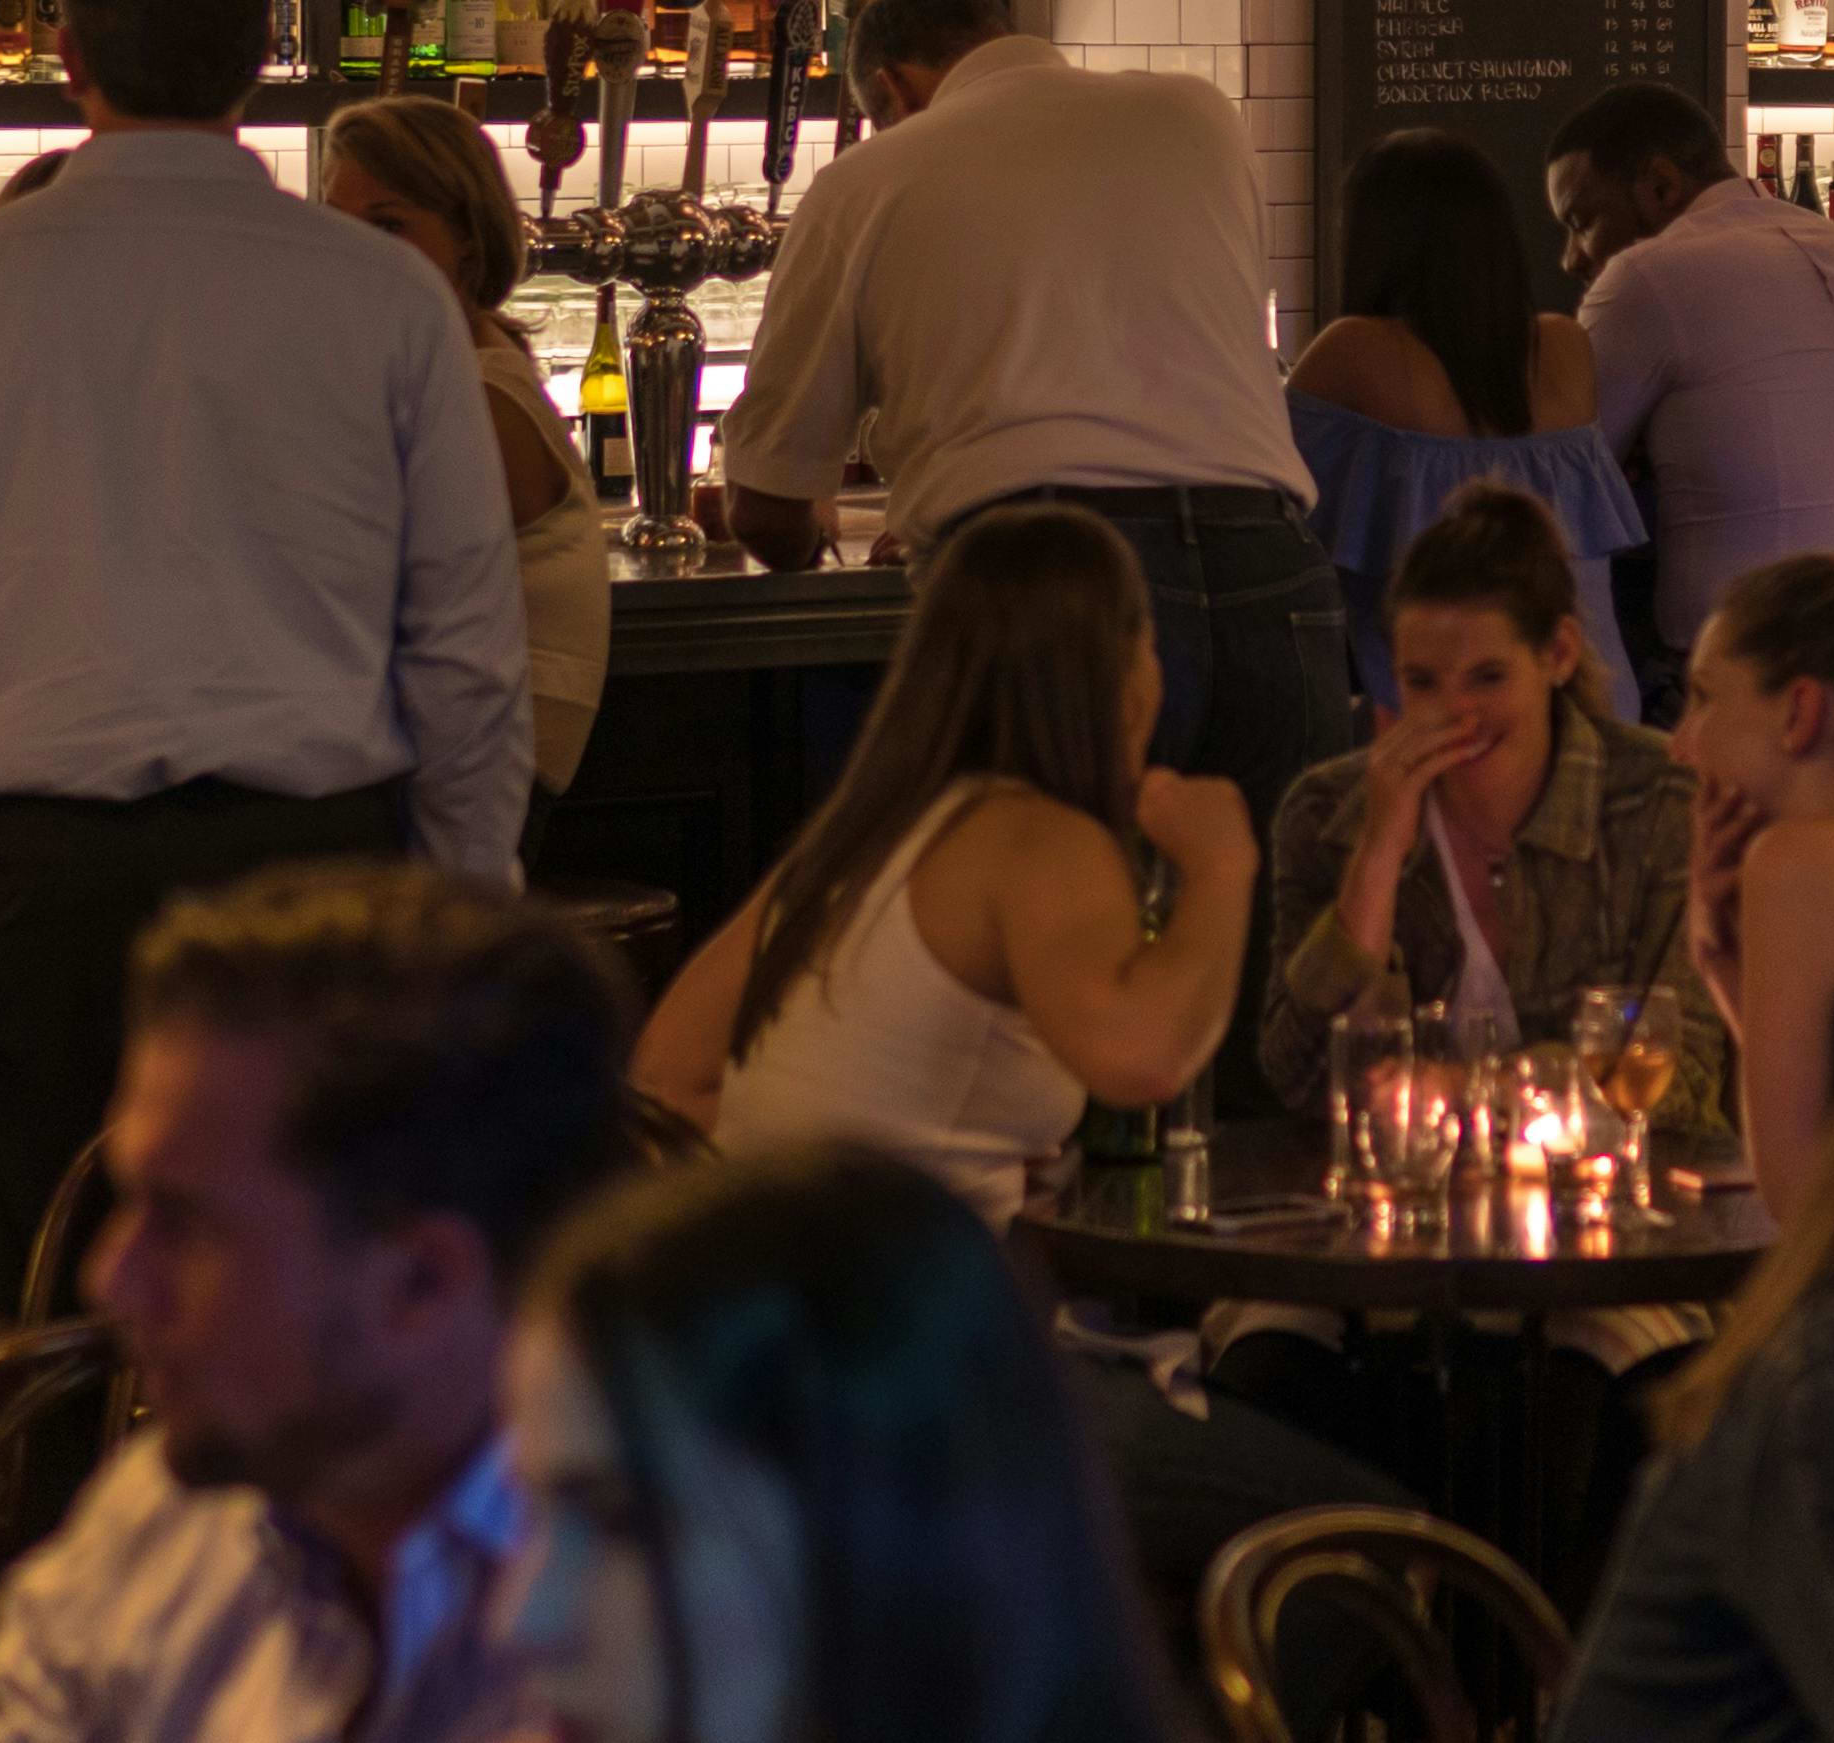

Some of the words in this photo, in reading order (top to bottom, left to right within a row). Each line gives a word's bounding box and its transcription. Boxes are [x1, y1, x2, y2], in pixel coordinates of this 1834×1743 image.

[1377, 40, 1434, 59] SYRAH
[1605, 40, 1619, 54] 12
[1377, 61, 1466, 82] CABERNET
[1470, 59, 1572, 80] SAUVIGNON
[1605, 63, 1620, 77] 15
[784, 65, 804, 143] KCBC
